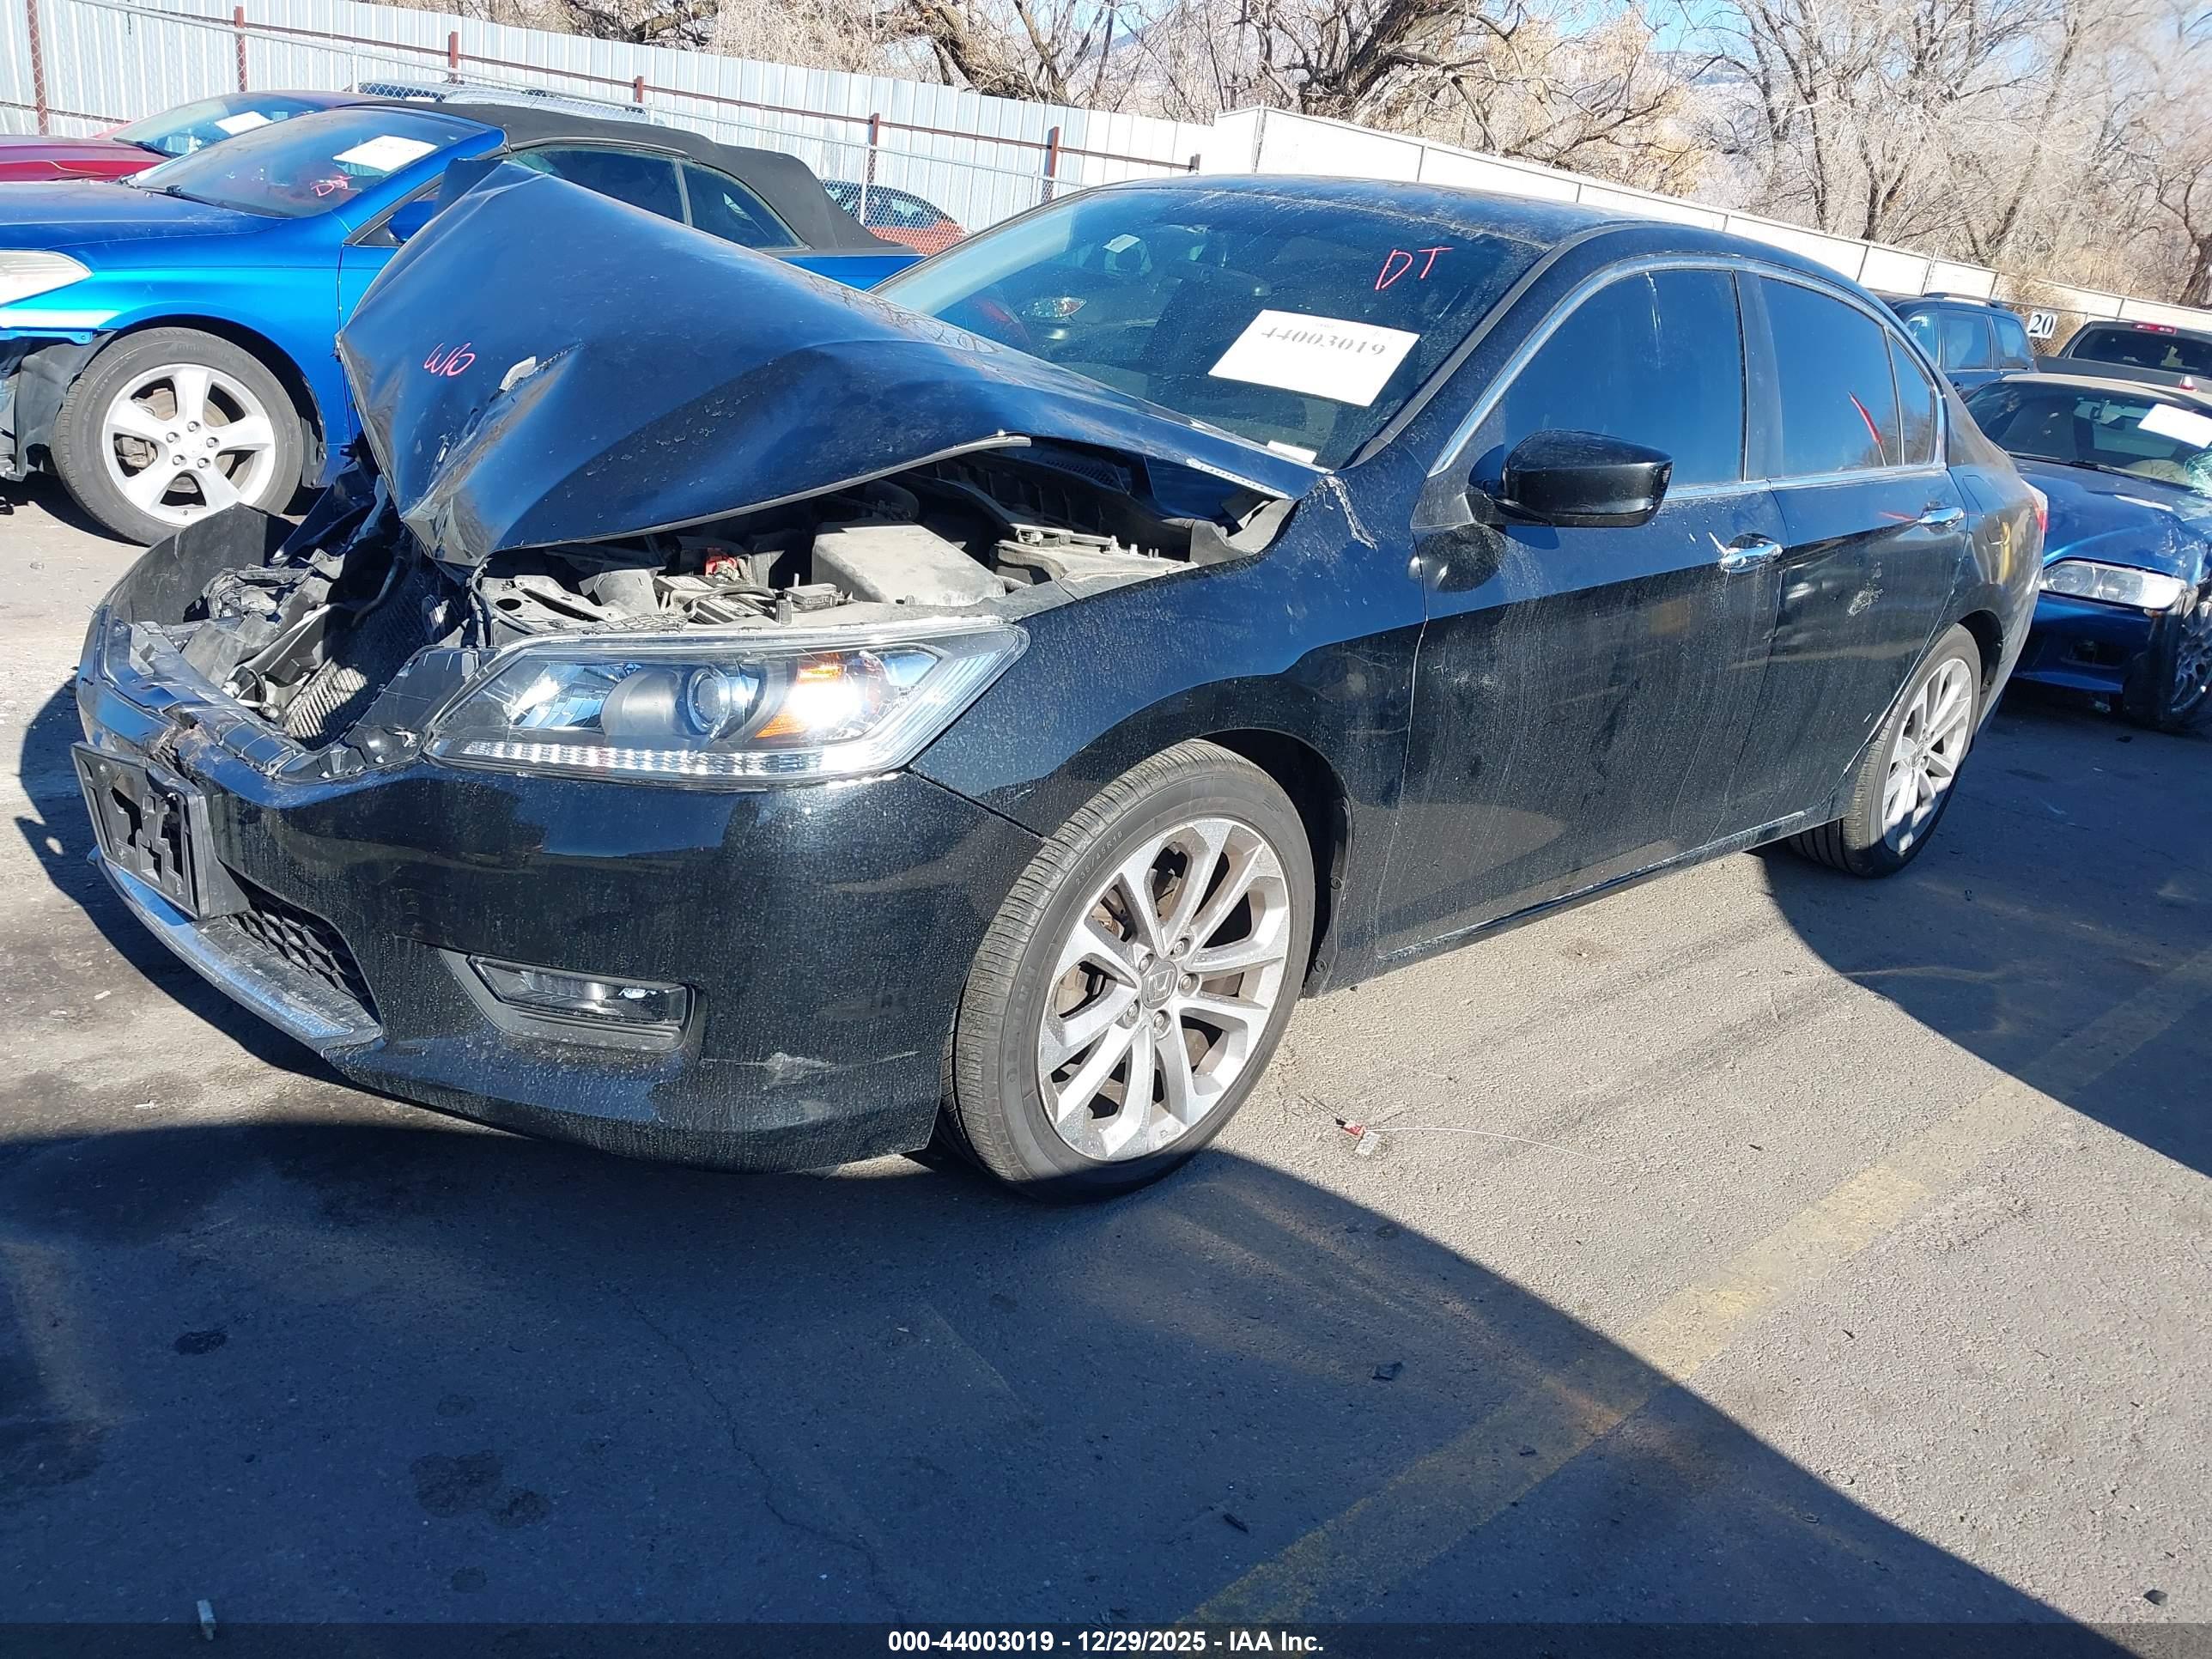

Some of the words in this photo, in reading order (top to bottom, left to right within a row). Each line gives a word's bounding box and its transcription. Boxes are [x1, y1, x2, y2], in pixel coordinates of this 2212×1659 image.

[1375, 246, 1455, 290] DT
[2027, 313, 2054, 336] 20
[1261, 326, 1386, 355] 44003019
